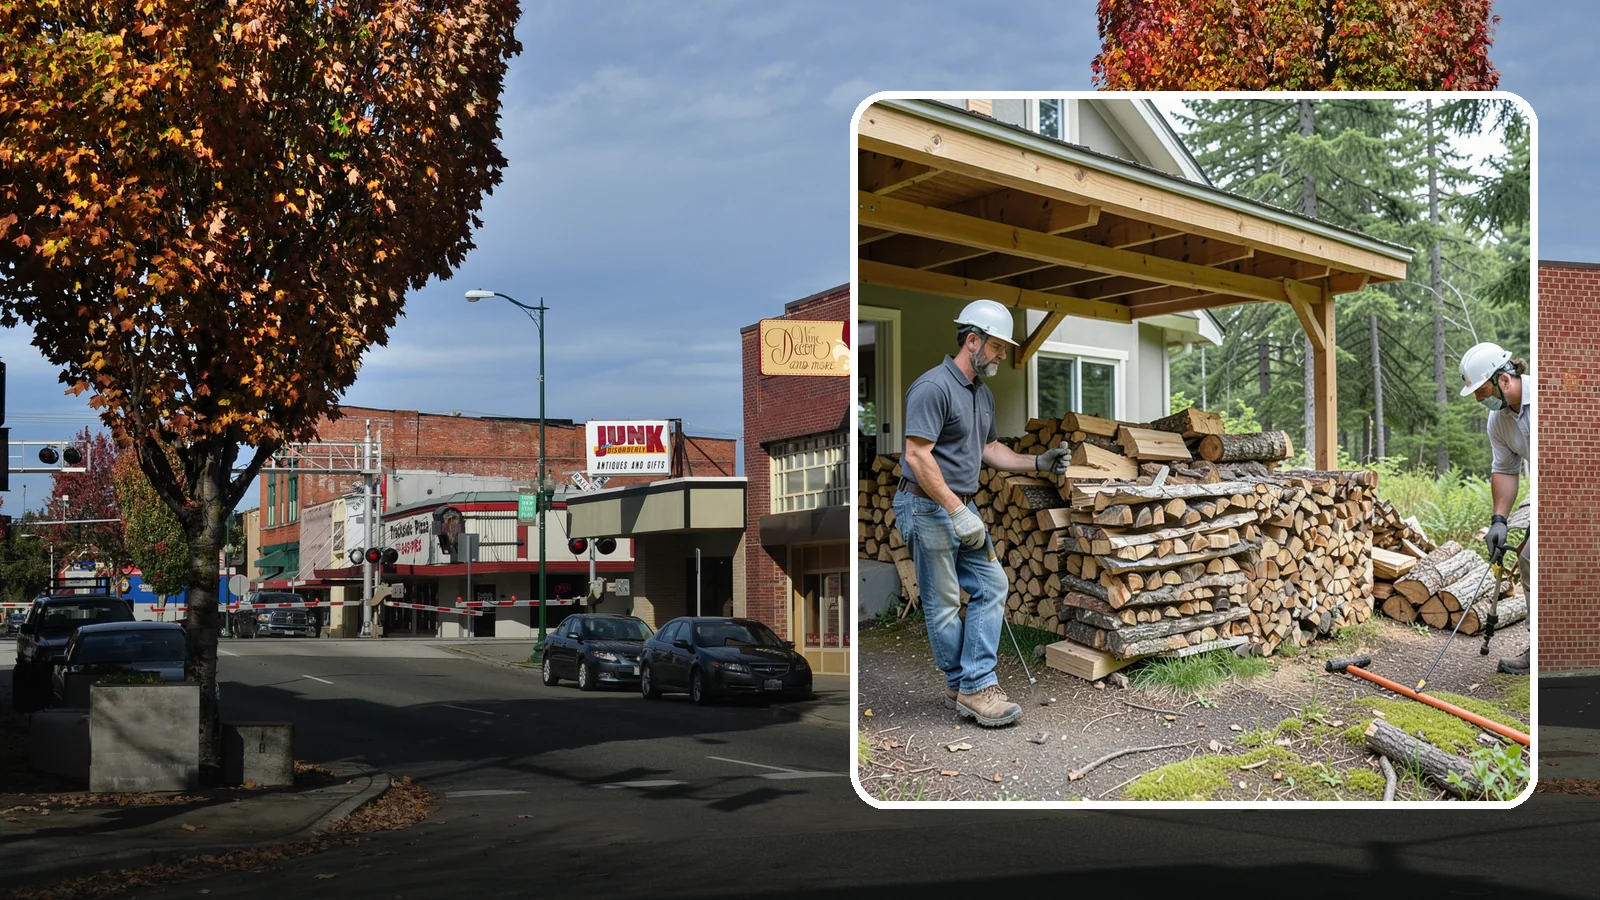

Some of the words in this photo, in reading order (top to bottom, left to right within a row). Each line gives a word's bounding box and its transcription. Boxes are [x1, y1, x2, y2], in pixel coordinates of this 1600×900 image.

[595, 425, 665, 457] JUNK
[607, 446, 646, 454] DISORDERLY
[597, 461, 628, 470] ANTIQUES
[631, 460, 644, 470] AND
[647, 460, 666, 470] GIFTS
[390, 521, 413, 540] Trackside
[414, 519, 429, 535] Pizza
